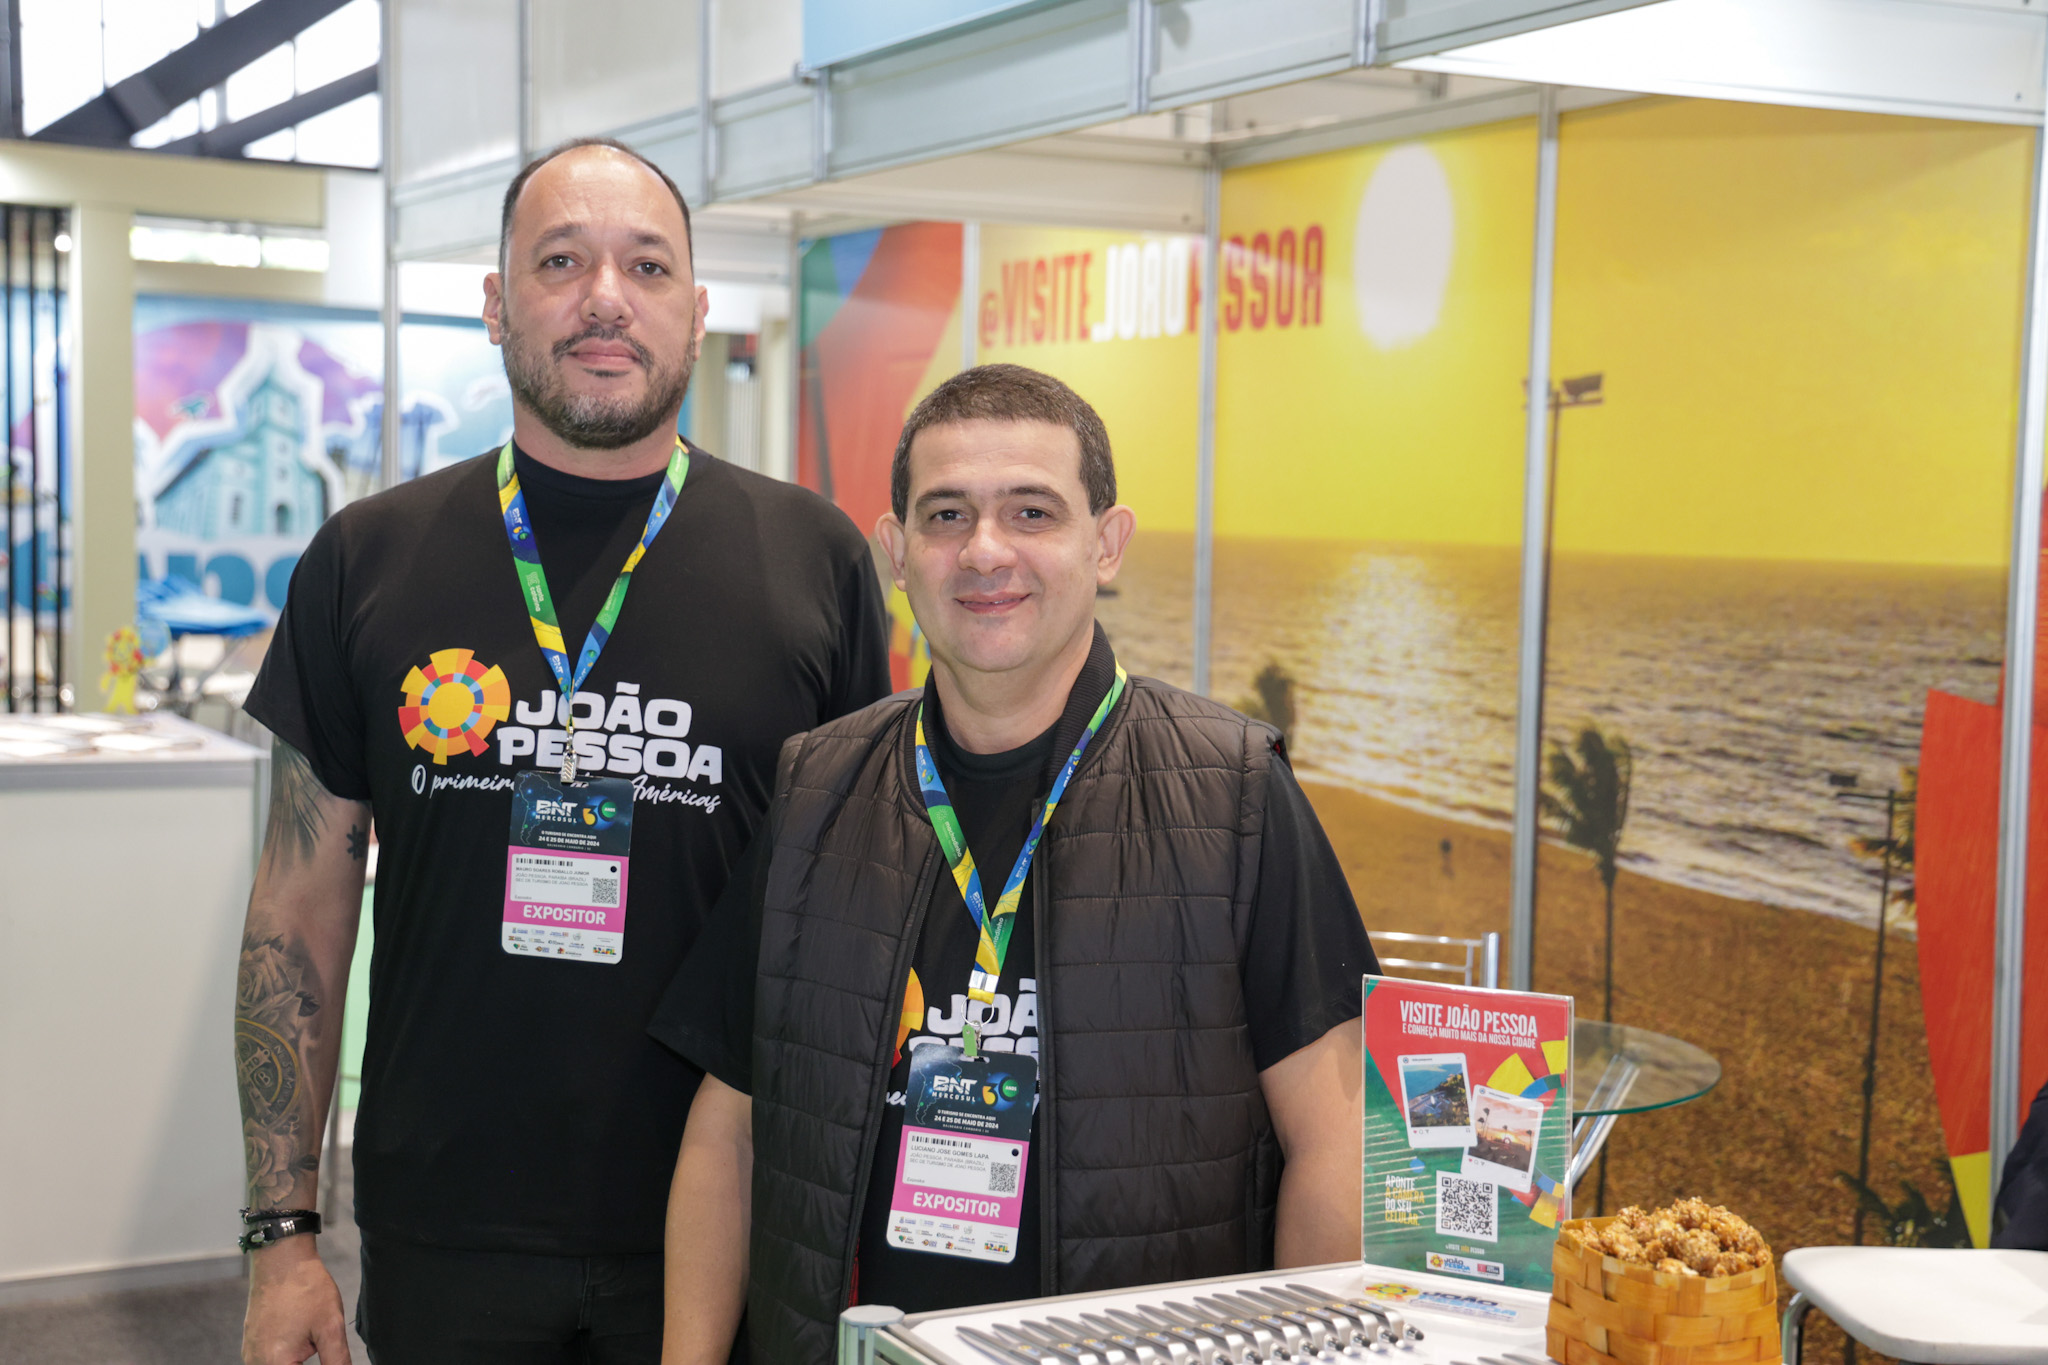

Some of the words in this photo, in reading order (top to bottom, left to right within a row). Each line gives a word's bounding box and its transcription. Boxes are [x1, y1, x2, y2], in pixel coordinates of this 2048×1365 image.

[516, 682, 692, 738] JOÃO
[497, 726, 723, 785] PESSOA
[411, 764, 427, 795] O
[632, 774, 722, 814] Américas
[536, 800, 578, 816] BNT
[535, 814, 578, 824] MERCOSUL
[523, 904, 606, 925] EXPOSITOR
[927, 978, 1038, 1035] JOÃ
[1400, 1000, 1442, 1026] VISITE
[1446, 1004, 1480, 1030] JOÃO
[1484, 1010, 1537, 1038] PESSOA
[1402, 1024, 1406, 1033] E
[1408, 1024, 1437, 1038] CONHEÇA
[1439, 1028, 1459, 1040] MUITO
[1460, 1031, 1477, 1042] MAIS
[1478, 1032, 1487, 1043] DA
[1489, 1034, 1510, 1046] NOSSA
[1512, 1036, 1536, 1049] CIDADE
[933, 1075, 978, 1095] BNT
[932, 1092, 976, 1102] MERCOSUL
[962, 1118, 976, 1126] MAIO
[985, 1121, 999, 1129] 2024
[952, 1150, 973, 1158] GOMES
[1385, 1186, 1391, 1198] A
[1386, 1174, 1416, 1190] APONTE
[913, 1191, 1001, 1218] EXPOSITOR
[1385, 1198, 1395, 1210] DO
[1397, 1199, 1412, 1213] SEU
